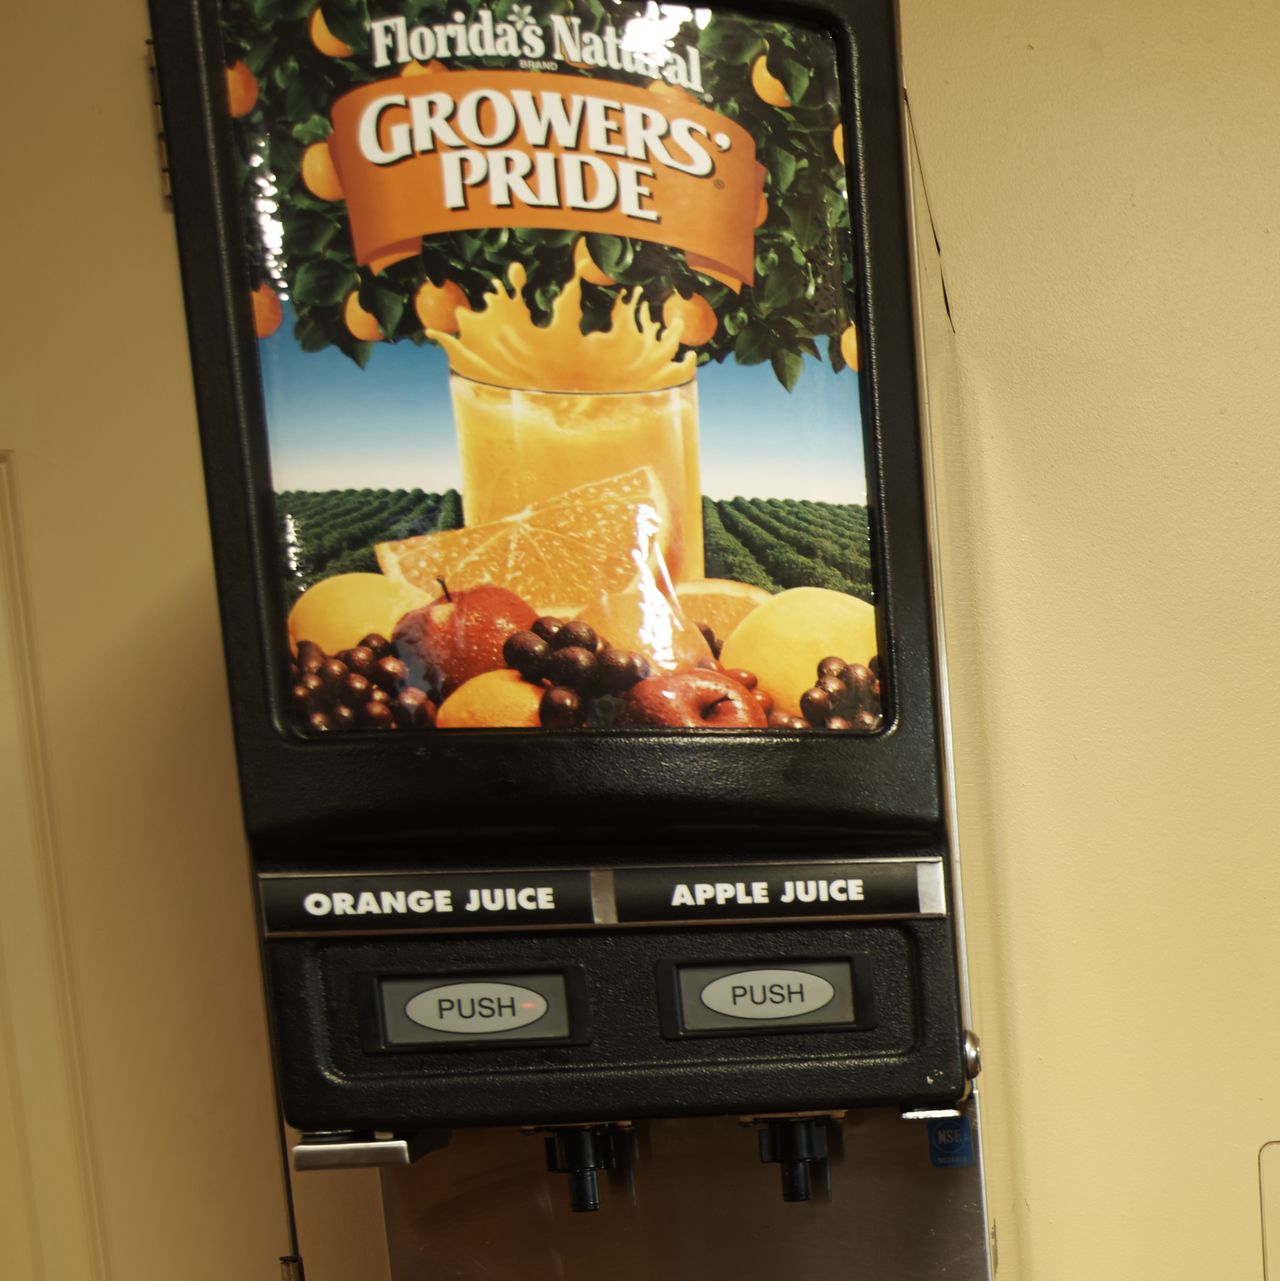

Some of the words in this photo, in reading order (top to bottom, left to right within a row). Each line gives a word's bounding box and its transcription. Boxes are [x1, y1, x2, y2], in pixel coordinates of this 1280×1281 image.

[371, 9, 546, 69] Florida's
[518, 58, 559, 72] BRAND
[358, 88, 731, 177] GROWERS'
[440, 149, 660, 222] PRIDE
[304, 890, 453, 916] ORANGE
[465, 887, 555, 912] JUICE
[671, 882, 769, 906] APPLE
[780, 879, 865, 903] JUICE
[437, 996, 516, 1020] PUSH
[731, 983, 805, 1005] PUSH
